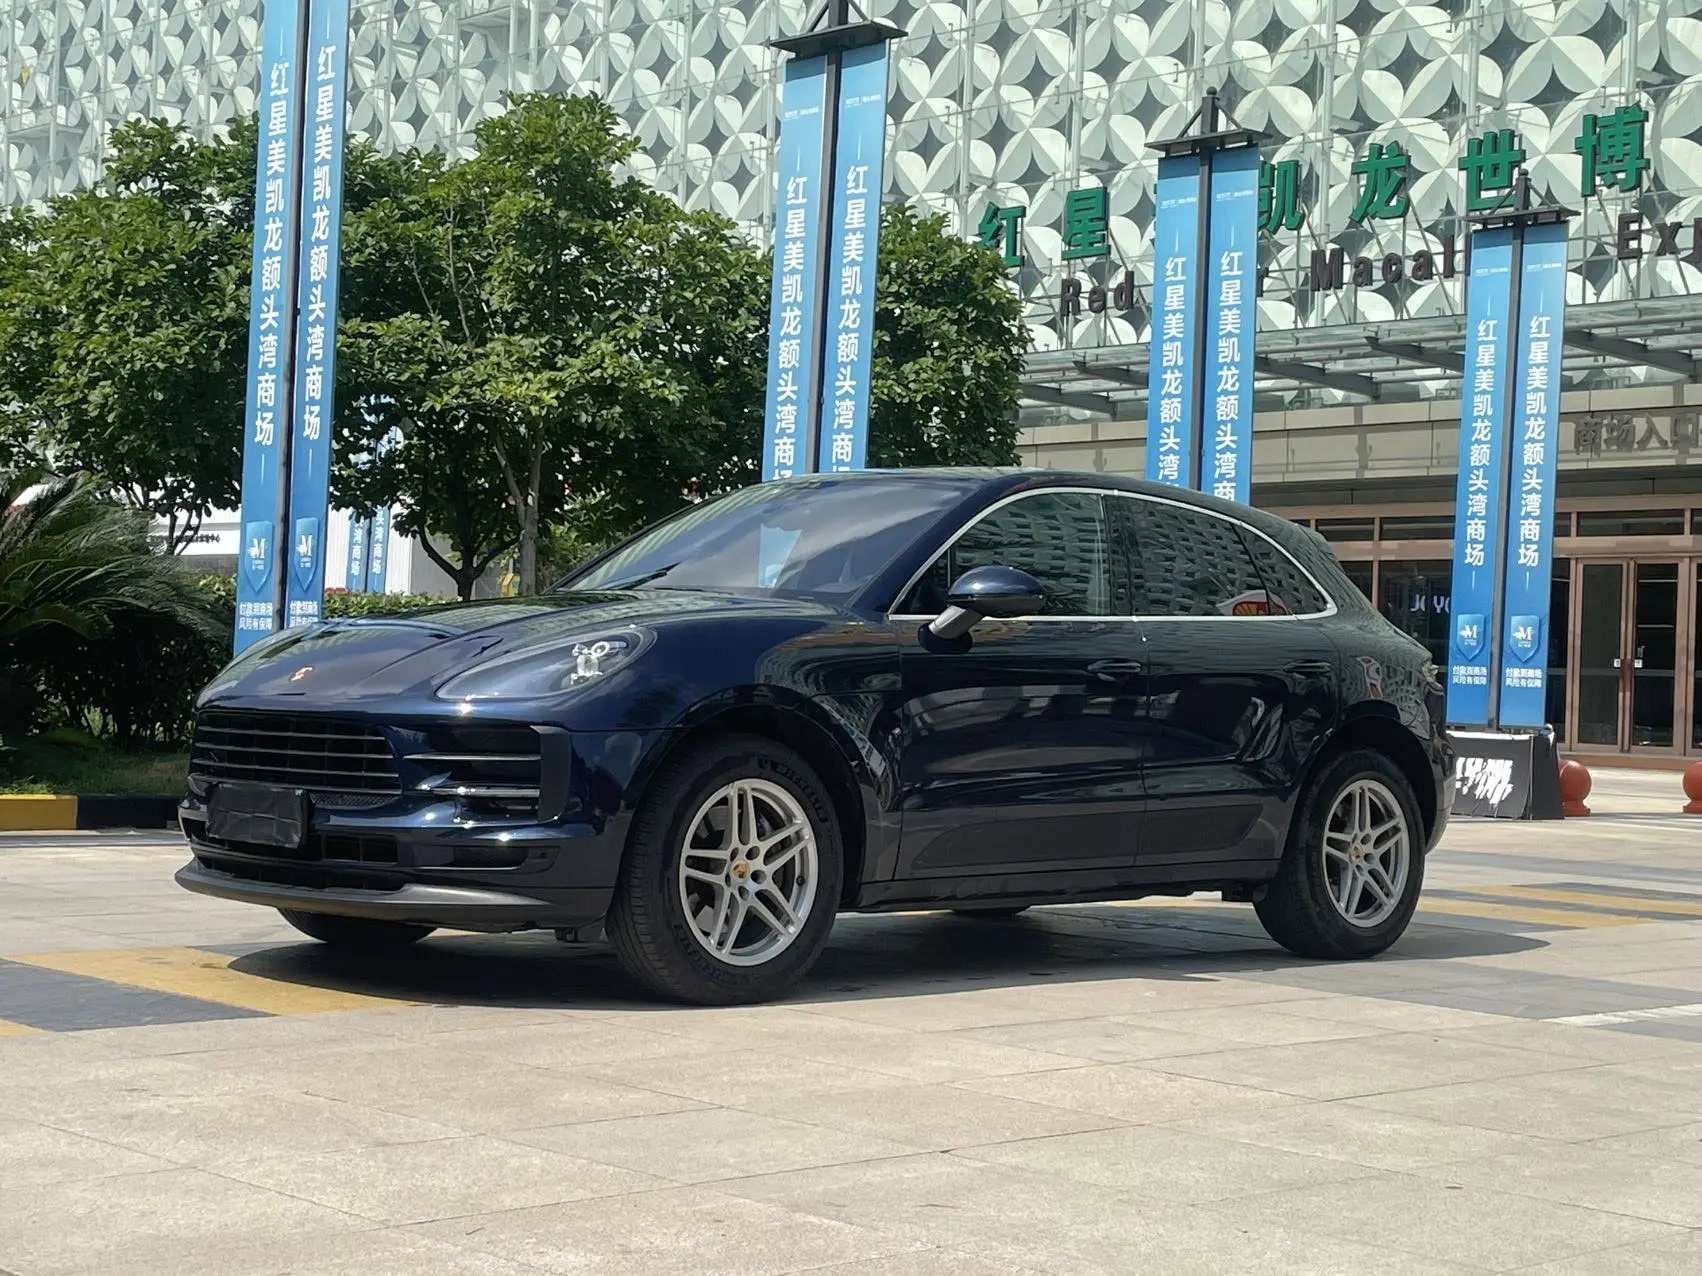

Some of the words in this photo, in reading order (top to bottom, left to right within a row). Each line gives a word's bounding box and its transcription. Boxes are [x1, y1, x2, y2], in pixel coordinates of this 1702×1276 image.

[254, 62, 289, 446] 红星美凯龙额头湾商场
[304, 45, 338, 440] 红星美凯龙额头湾商场
[977, 103, 1651, 267] 红星凯龙世博
[1060, 270, 1135, 316] Red
[831, 164, 869, 472] 红星美凯龙额头湾商
[1157, 257, 1187, 487] 红星美凯龙额头湾
[1518, 315, 1551, 567] 红星美凯龙额头湾商场
[1573, 411, 1700, 459] 商场入口
[1465, 319, 1498, 567] 红星美凯龙额头湾商场
